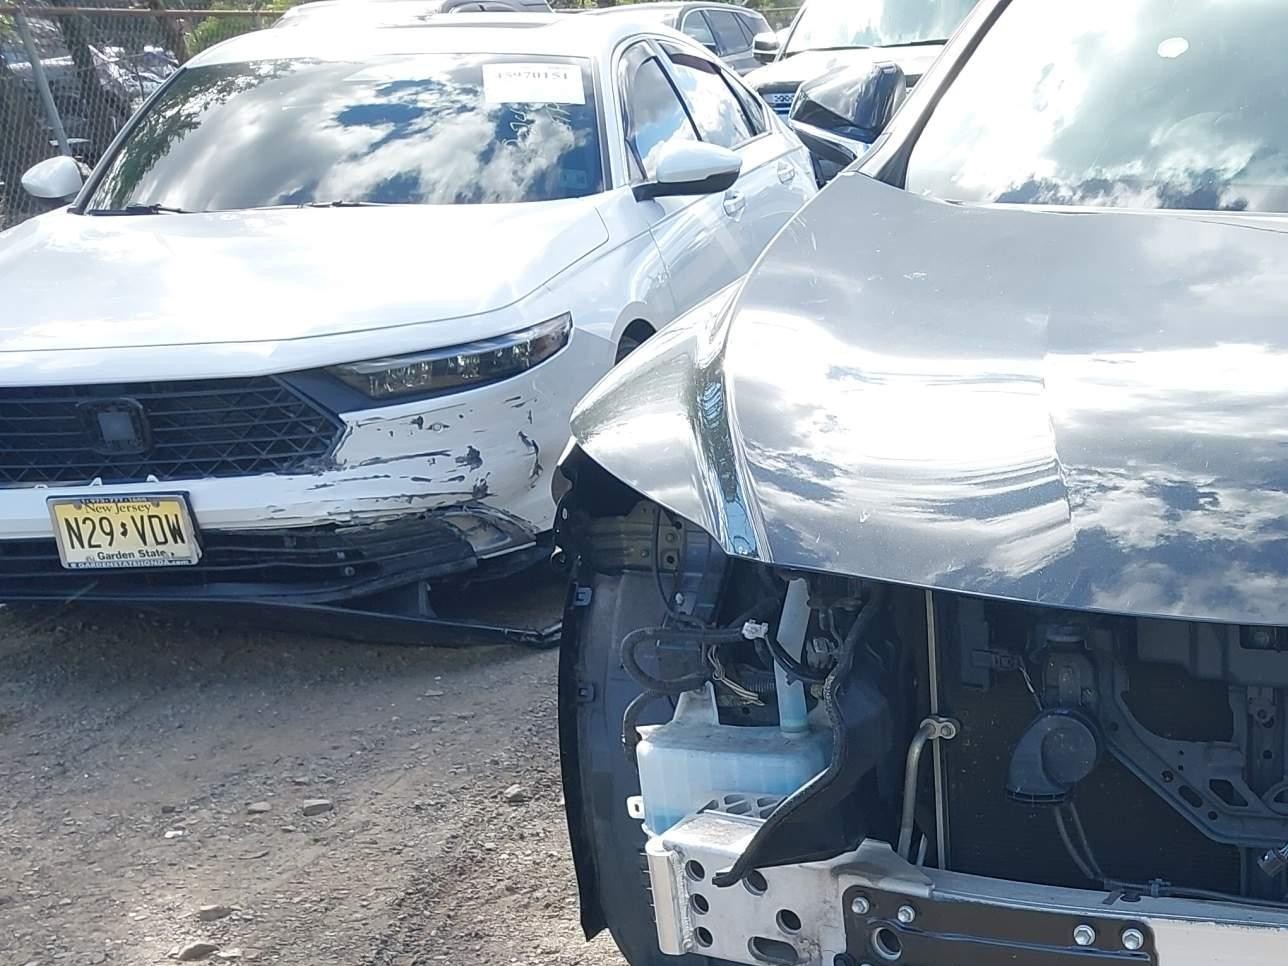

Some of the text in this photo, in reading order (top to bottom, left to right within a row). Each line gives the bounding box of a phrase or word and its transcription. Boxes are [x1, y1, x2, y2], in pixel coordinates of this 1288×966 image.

[86, 502, 151, 514] New Jersey
[64, 513, 186, 550] N29 VDW
[97, 548, 168, 561] Garden State
